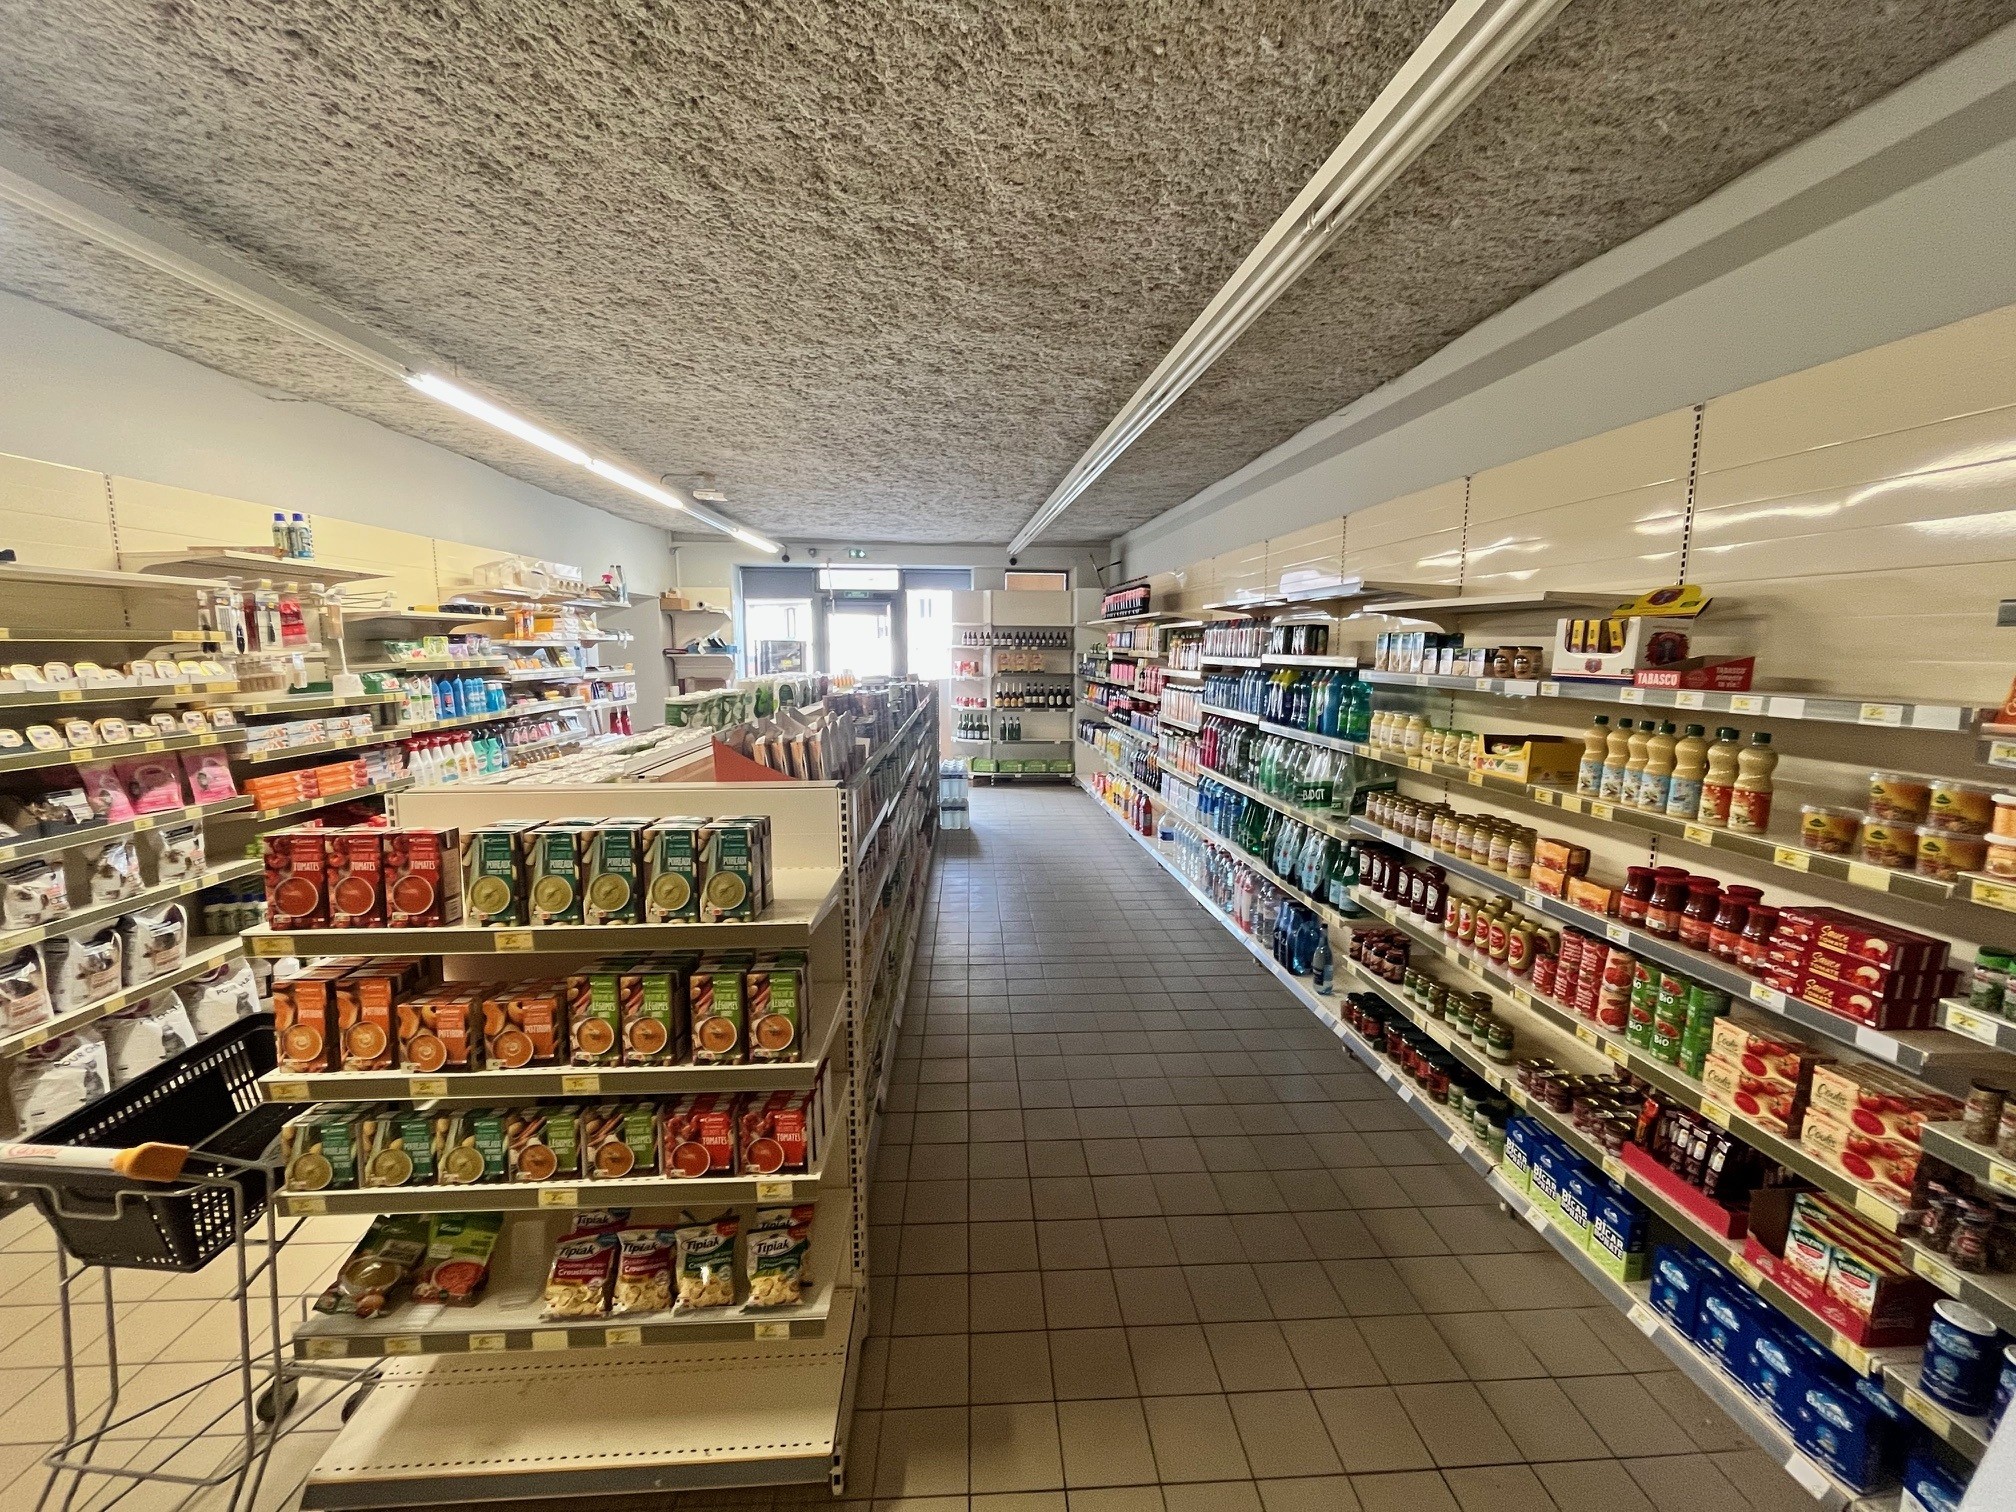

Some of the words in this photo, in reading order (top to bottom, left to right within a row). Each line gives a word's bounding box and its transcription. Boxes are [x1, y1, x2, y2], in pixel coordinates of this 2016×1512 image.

[1637, 672, 1679, 686] TABASCO
[293, 861, 320, 872] TOMATES
[351, 861, 376, 872] TOMATES
[411, 860, 436, 871] TOMATES
[1821, 925, 1849, 943] Sauce
[1812, 951, 1841, 970] Sauce
[1805, 979, 1834, 998] Sauce
[702, 1136, 727, 1145] TOMATES
[776, 1133, 801, 1142] TOMATES
[577, 1214, 609, 1225] Tipiak
[623, 1241, 658, 1254] Tipiak
[686, 1236, 720, 1251] Tipiak
[756, 1238, 790, 1254] Tipiak
[560, 1244, 596, 1258] Tipiak
